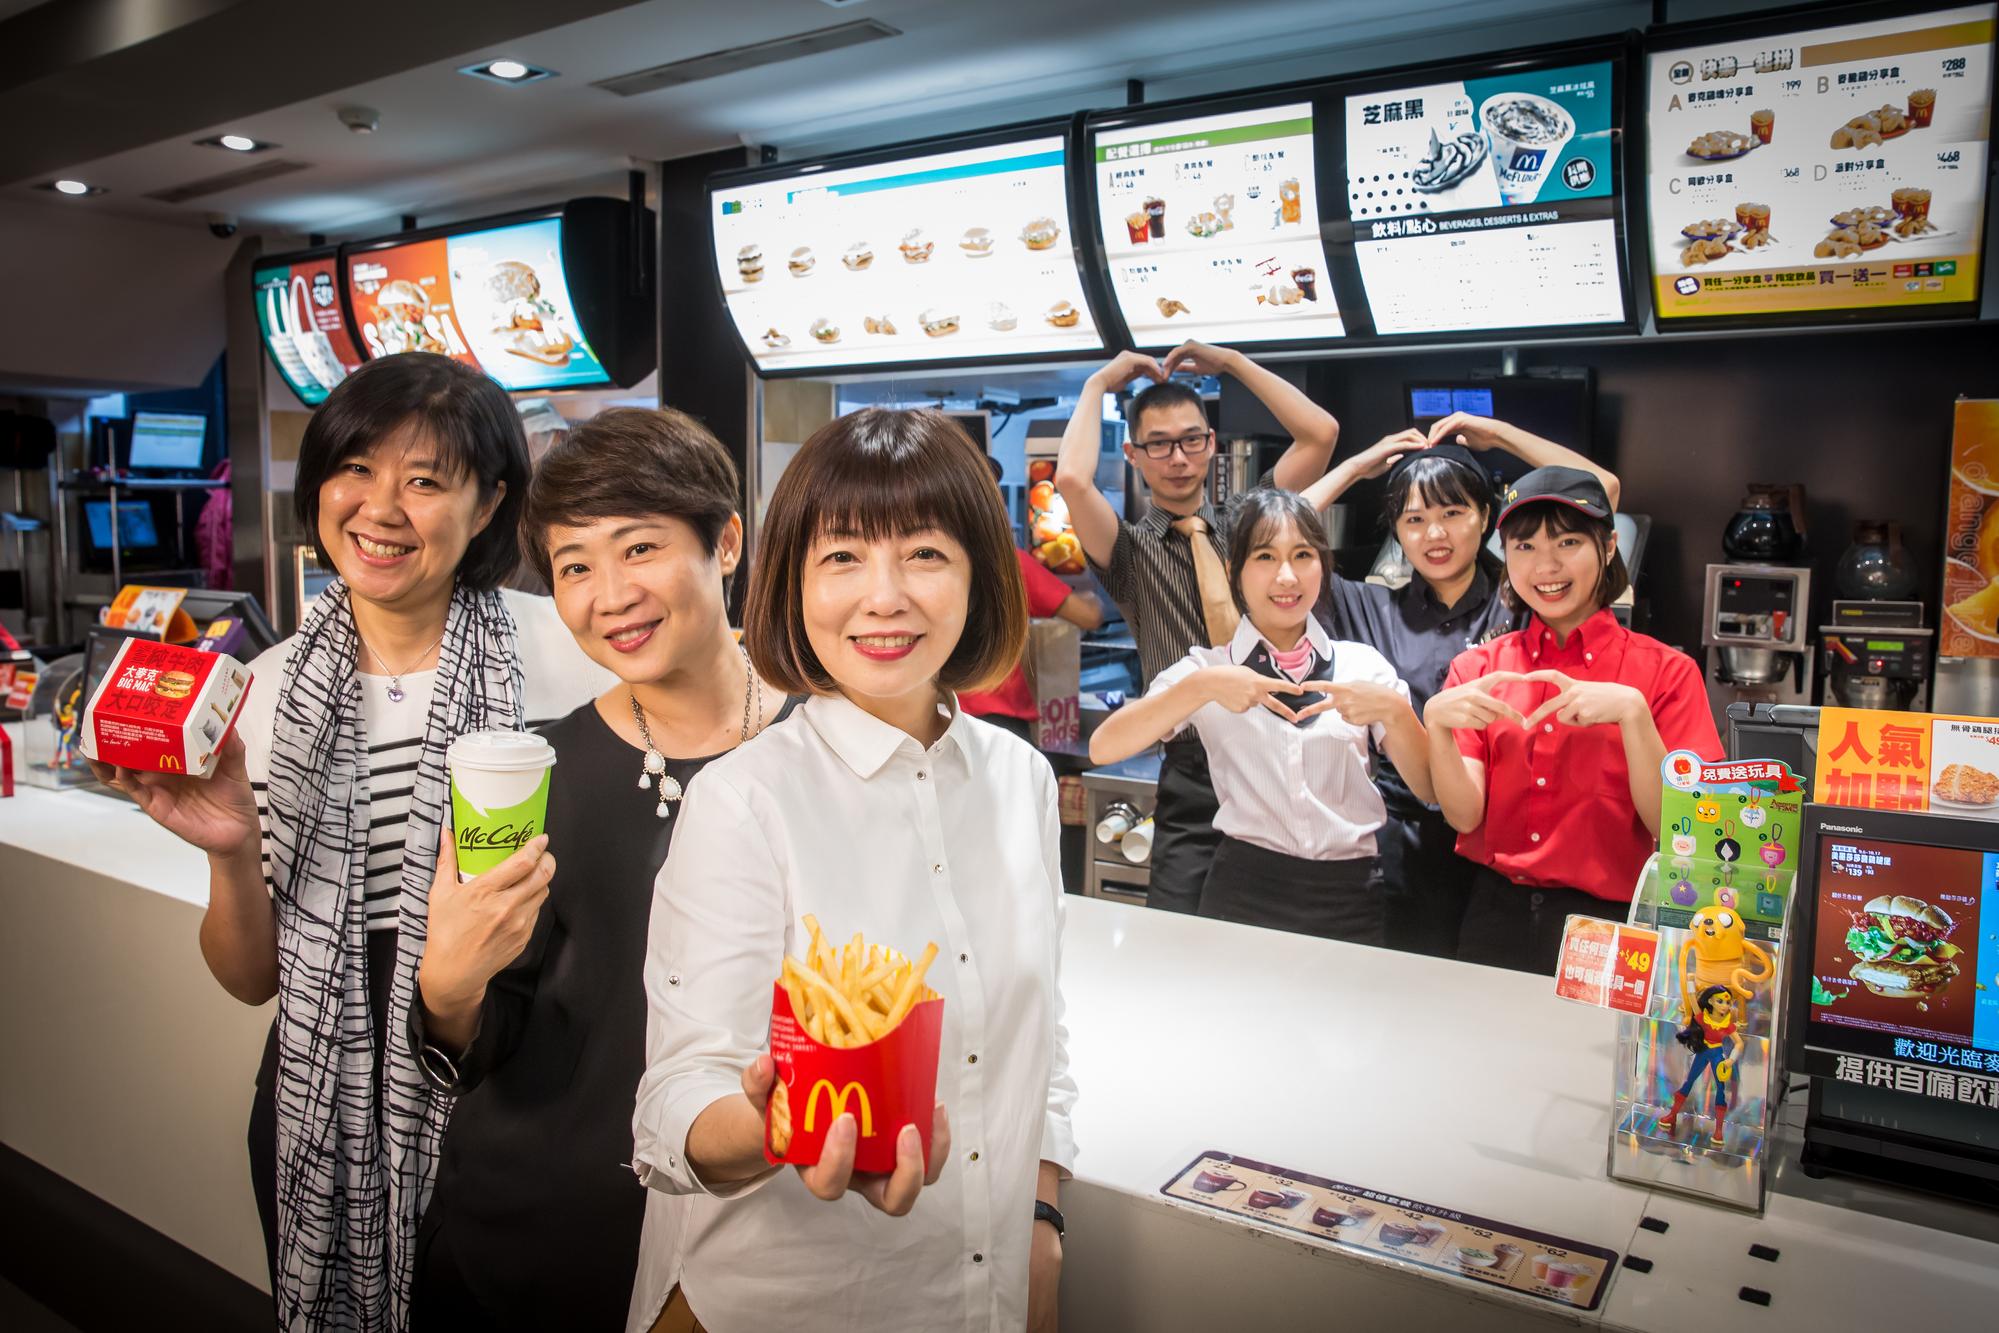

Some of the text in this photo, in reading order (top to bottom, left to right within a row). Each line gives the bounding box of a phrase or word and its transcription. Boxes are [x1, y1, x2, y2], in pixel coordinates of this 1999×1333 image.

[1363, 98, 1424, 125] 芝麻黑
[1668, 94, 1682, 112] A
[1814, 164, 1828, 182] D
[1669, 178, 1681, 194] C
[1484, 214, 1522, 227] DESSERTS
[1529, 210, 1559, 222] EXTRAS
[123, 665, 160, 682] 大麥克
[116, 677, 153, 693] BIG MAC
[1828, 721, 1926, 769] 人氣
[1702, 764, 1783, 782] 免費送玩具
[1825, 768, 1924, 812] 加點
[460, 820, 535, 852] McCafé
[1820, 822, 1864, 834] Panasonic
[1894, 1037, 1999, 1073] 歡迎光臨麥
